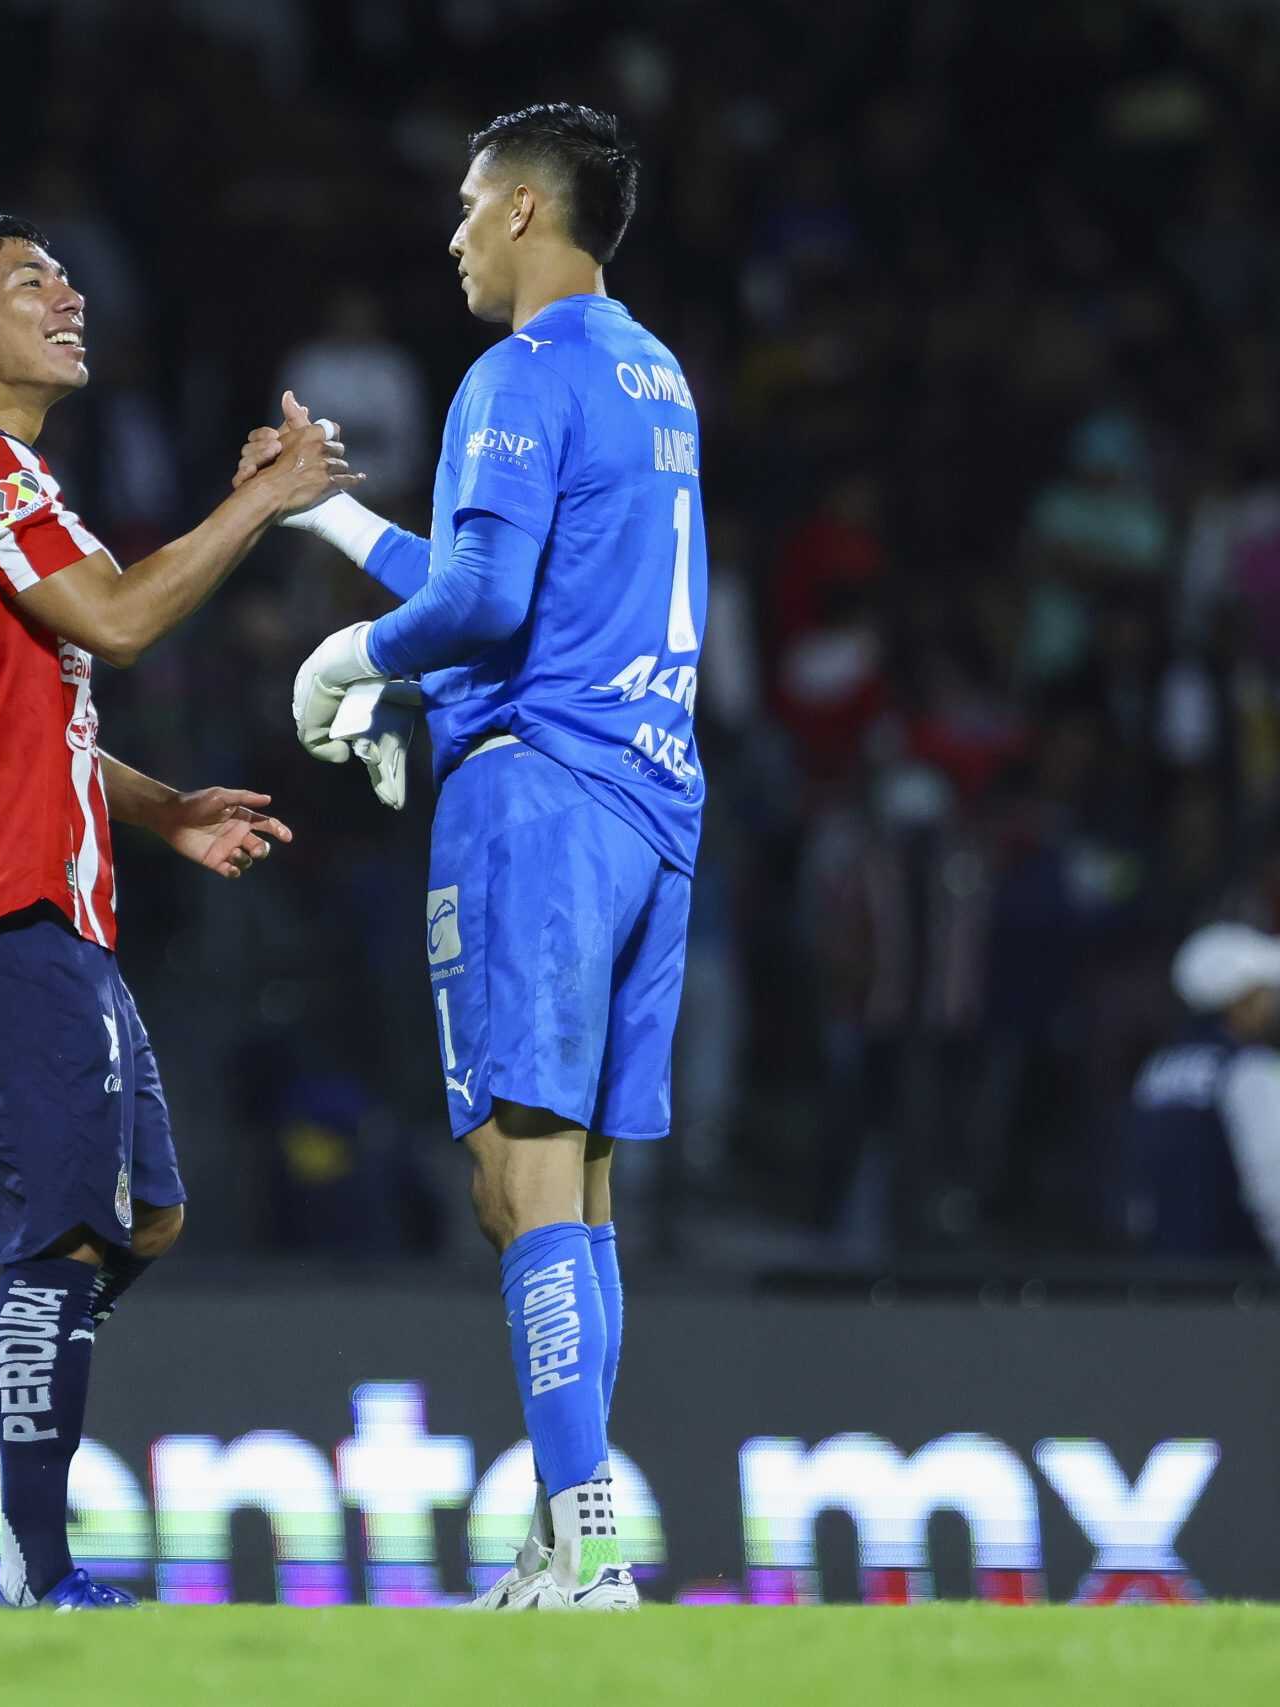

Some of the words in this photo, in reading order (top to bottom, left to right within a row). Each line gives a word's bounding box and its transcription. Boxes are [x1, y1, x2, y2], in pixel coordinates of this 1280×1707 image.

[480, 428, 532, 457] GNP
[653, 426, 699, 477] RANGE
[668, 488, 698, 654] 1
[631, 722, 697, 778] AXE
[438, 987, 456, 1071] 1
[523, 1257, 581, 1397] PERDURA
